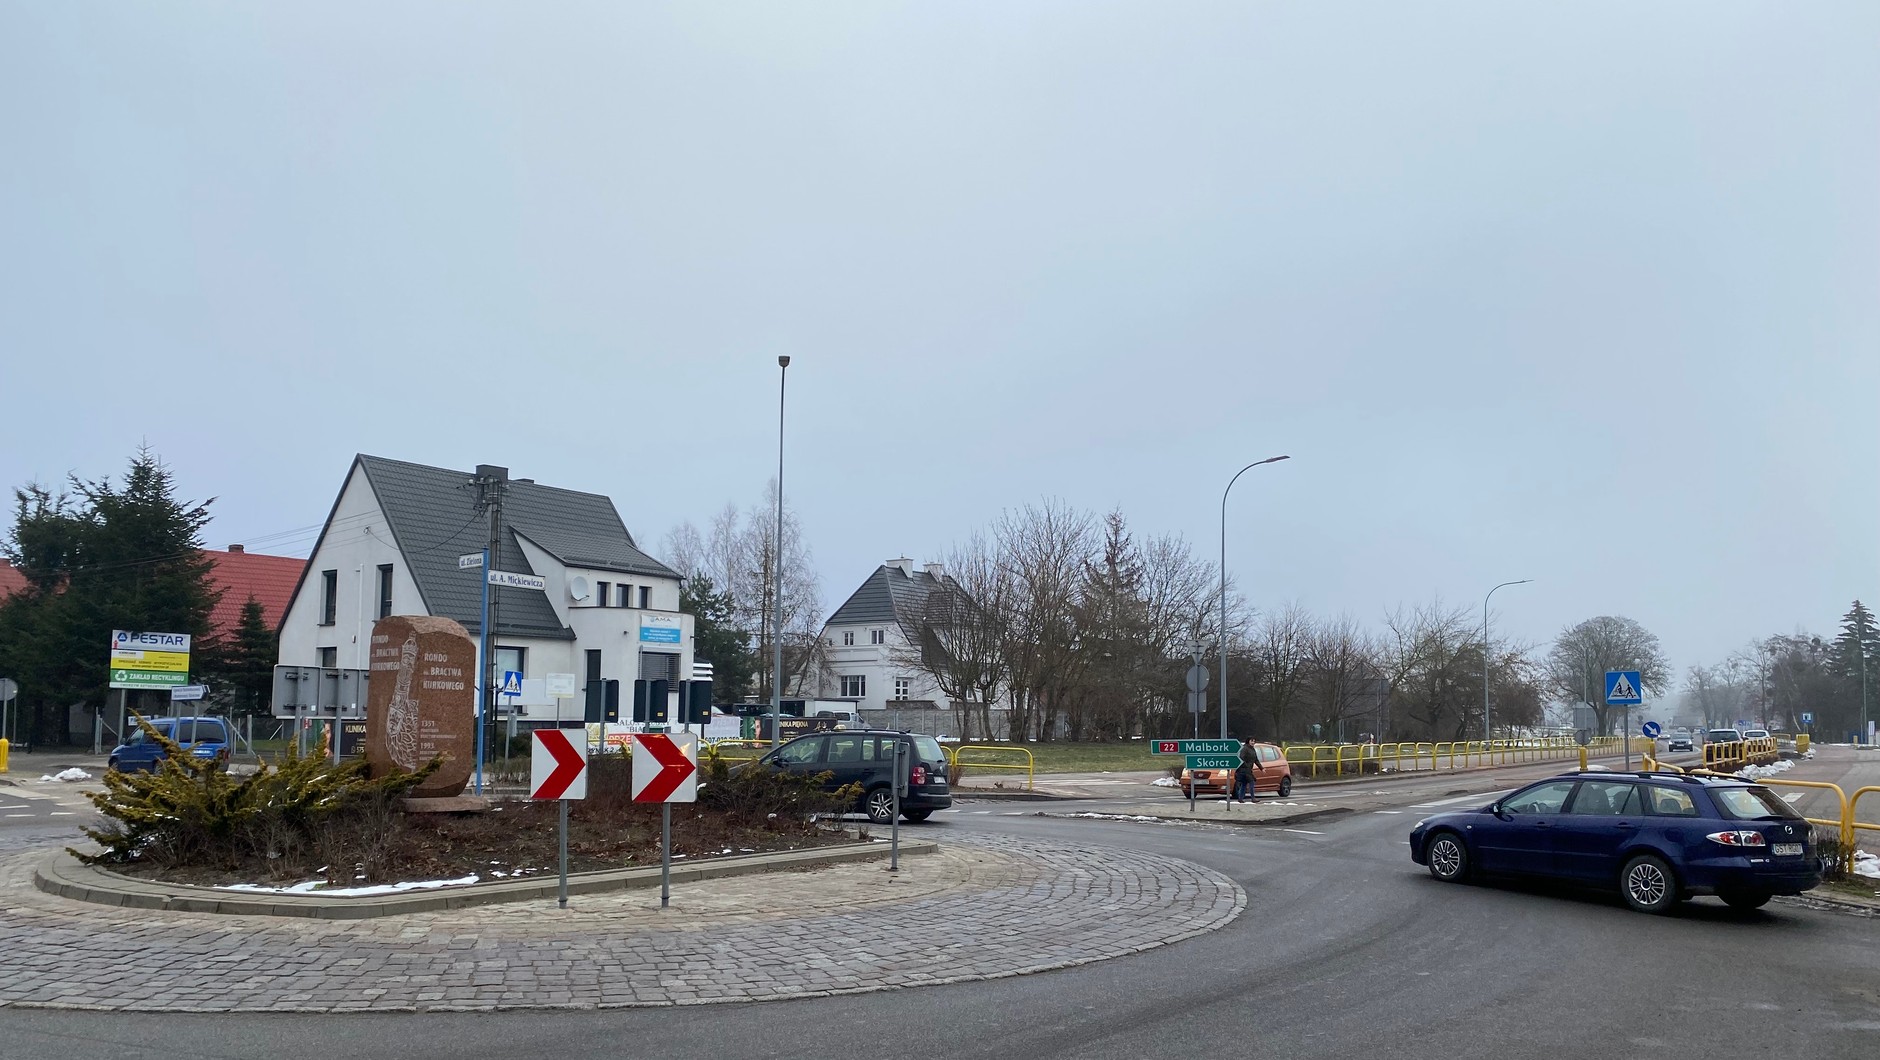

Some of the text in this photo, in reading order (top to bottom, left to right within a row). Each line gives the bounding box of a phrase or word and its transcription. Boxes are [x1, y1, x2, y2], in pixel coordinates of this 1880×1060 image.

[490, 573, 498, 581] ul.
[130, 633, 184, 646] PESTAR
[424, 653, 448, 662] RONDO
[430, 667, 462, 676] BRACTWA
[422, 681, 464, 690] KURKOWEGO
[1164, 742, 1229, 752] 22 Malbork
[1196, 758, 1230, 767] Skórcz
